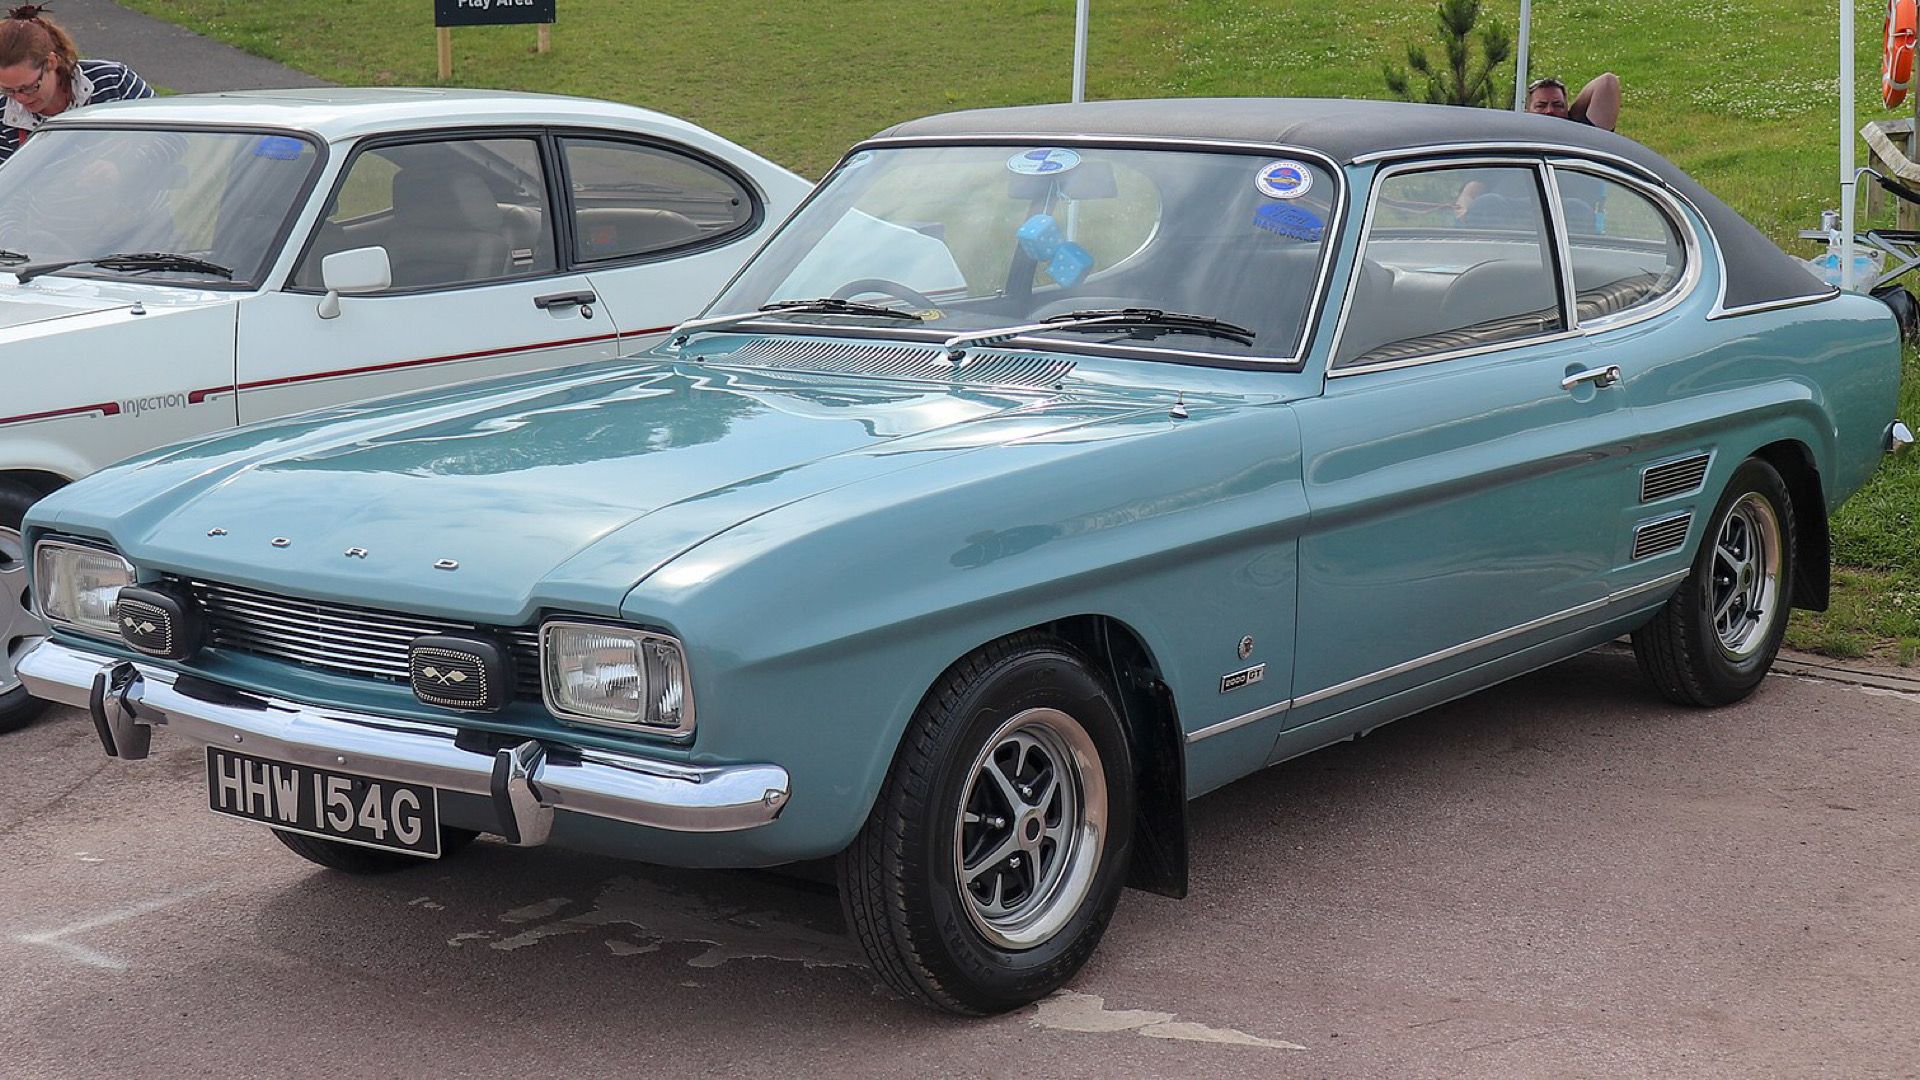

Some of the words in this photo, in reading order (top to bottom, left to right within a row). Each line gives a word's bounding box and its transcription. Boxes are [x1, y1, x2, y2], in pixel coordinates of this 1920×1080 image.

[458, 0, 490, 9] Play
[207, 527, 459, 571] FORD
[1249, 669, 1262, 680] GT
[217, 754, 299, 823] HHW
[313, 773, 422, 845] 154G
